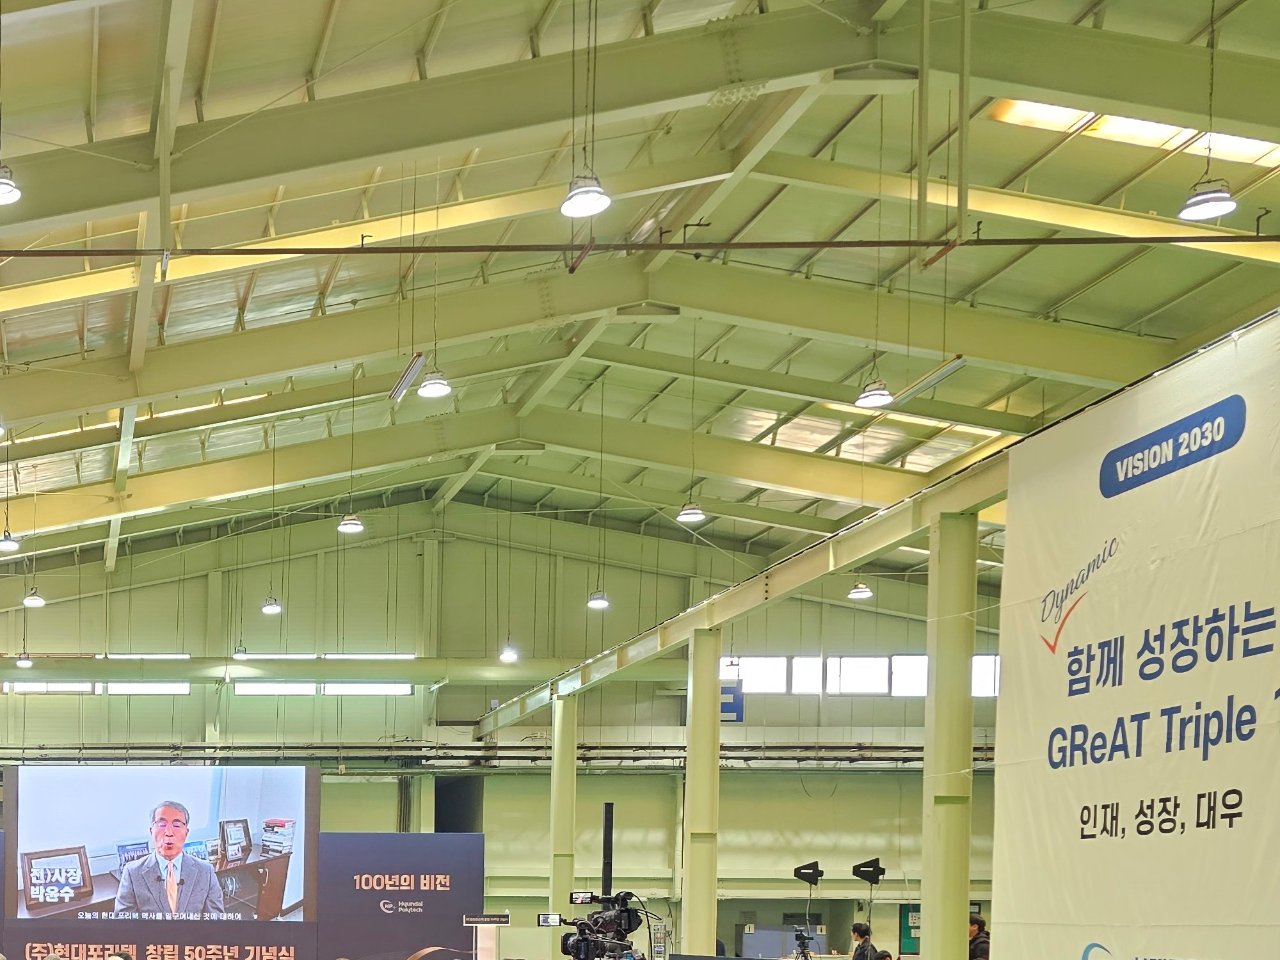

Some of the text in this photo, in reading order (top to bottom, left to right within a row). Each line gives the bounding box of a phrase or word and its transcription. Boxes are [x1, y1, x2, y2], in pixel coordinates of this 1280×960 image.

[1116, 416, 1225, 482] VISION 2030
[1041, 537, 1119, 624] Dynamic
[1067, 600, 1277, 697] 함께 성장하는
[1047, 695, 1257, 770] GReAT Triple
[1080, 788, 1243, 839] 인재, 성장, 대우
[353, 874, 450, 891] 100년의 비전
